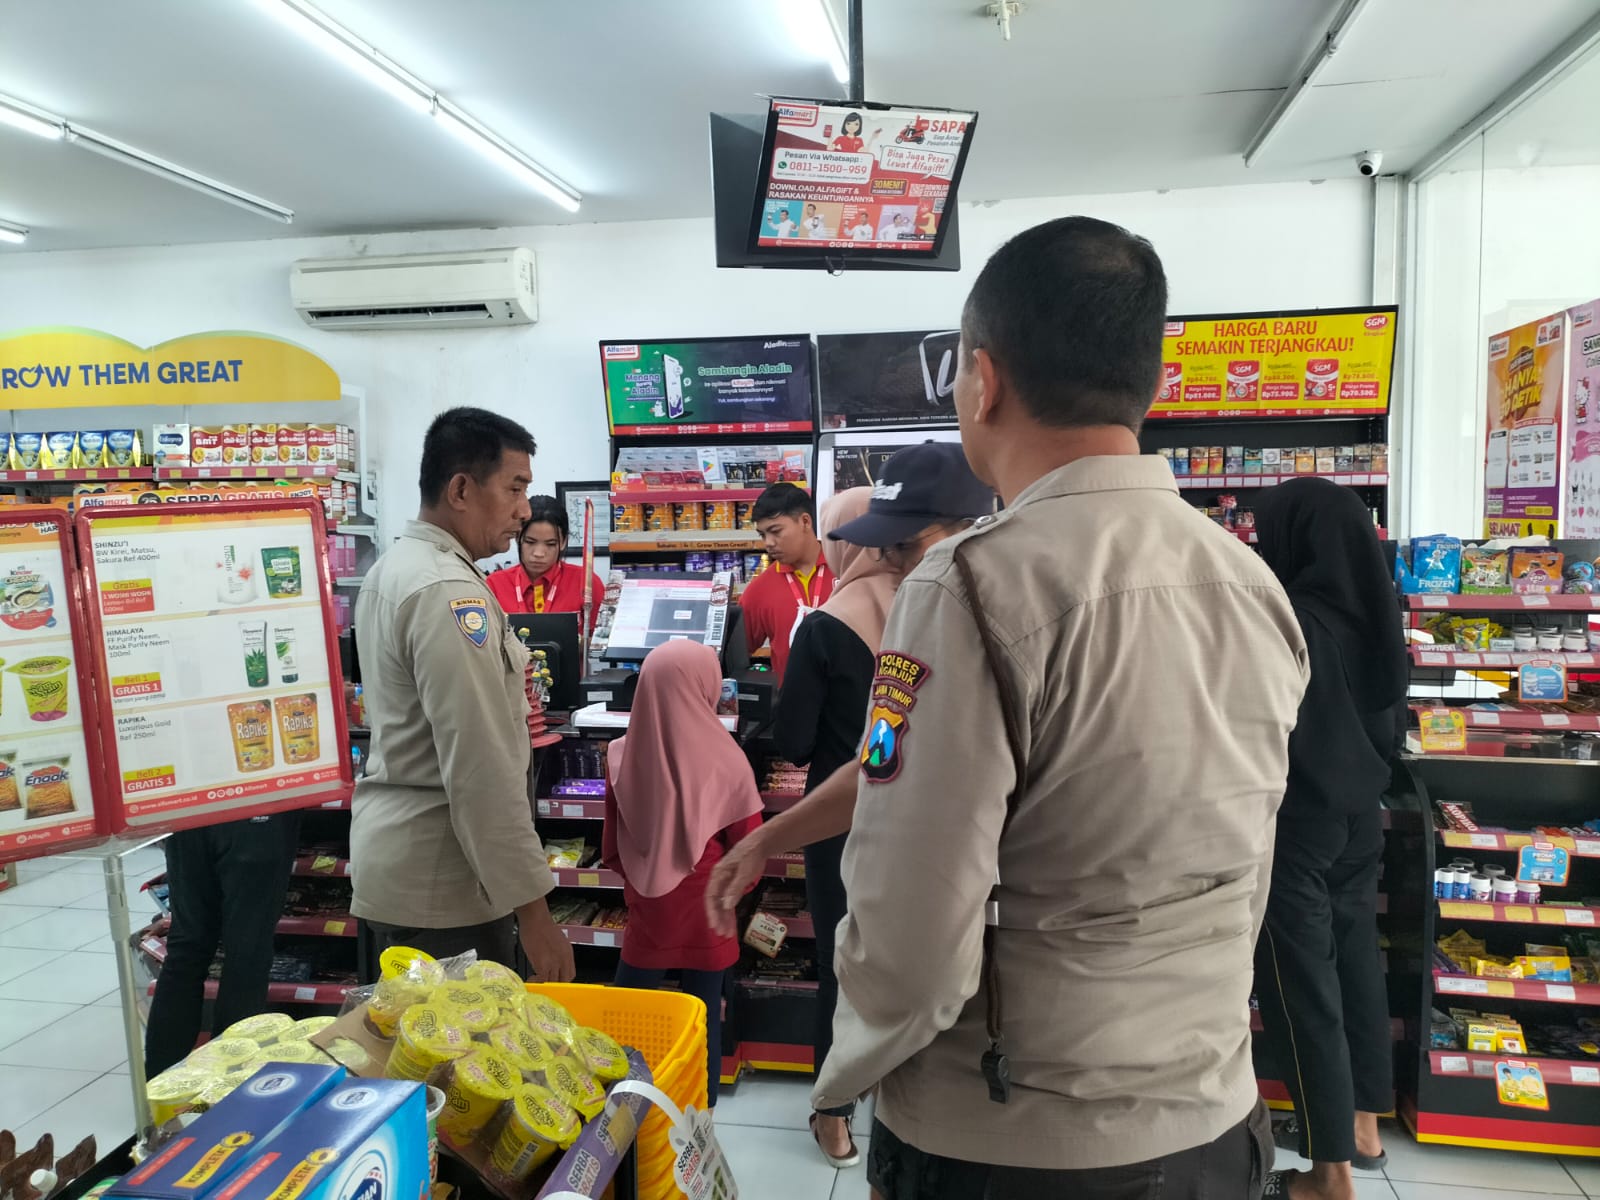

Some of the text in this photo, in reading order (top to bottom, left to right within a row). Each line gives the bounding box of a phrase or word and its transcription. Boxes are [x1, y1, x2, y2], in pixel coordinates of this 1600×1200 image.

[930, 119, 967, 133] SAPA
[784, 151, 808, 159] Pesan
[822, 154, 859, 163] Whatsapp
[789, 161, 867, 174] 0811-1500-959
[770, 183, 815, 193] DOWNLOAD
[816, 186, 852, 195] ALFAGIFT
[768, 191, 807, 200] RASAKAN
[807, 192, 875, 204] KEUNTUNGANNYA
[1214, 320, 1318, 337] HARGA BARU
[1365, 317, 1387, 328] SGM
[763, 340, 788, 349] Aladin
[1176, 337, 1354, 357] SEMAKIN TERJANGKAU!
[758, 362, 793, 374] Aladin
[0, 360, 243, 390] ROW THEM GREAT
[1488, 521, 1521, 536] SELAMAT
[96, 556, 123, 564] Sakura
[136, 553, 160, 561] 400ml
[112, 581, 140, 590] Gratis
[1418, 578, 1456, 589] FROZEN
[106, 627, 144, 636] HIMALAYA
[117, 635, 137, 643] Purify
[880, 654, 920, 676] POLRES
[879, 665, 917, 686] NGANJUK
[115, 684, 151, 696] GRATIS
[887, 686, 913, 707] TIMUR
[117, 716, 147, 725] RAPIKA
[154, 719, 172, 728] Gold
[127, 776, 173, 791] GRATIS 1
[1446, 803, 1479, 832] KOPIKO
[677, 1141, 695, 1173] SERBA
[568, 1150, 592, 1190] SERBA
[682, 1149, 700, 1185] GRATIS
